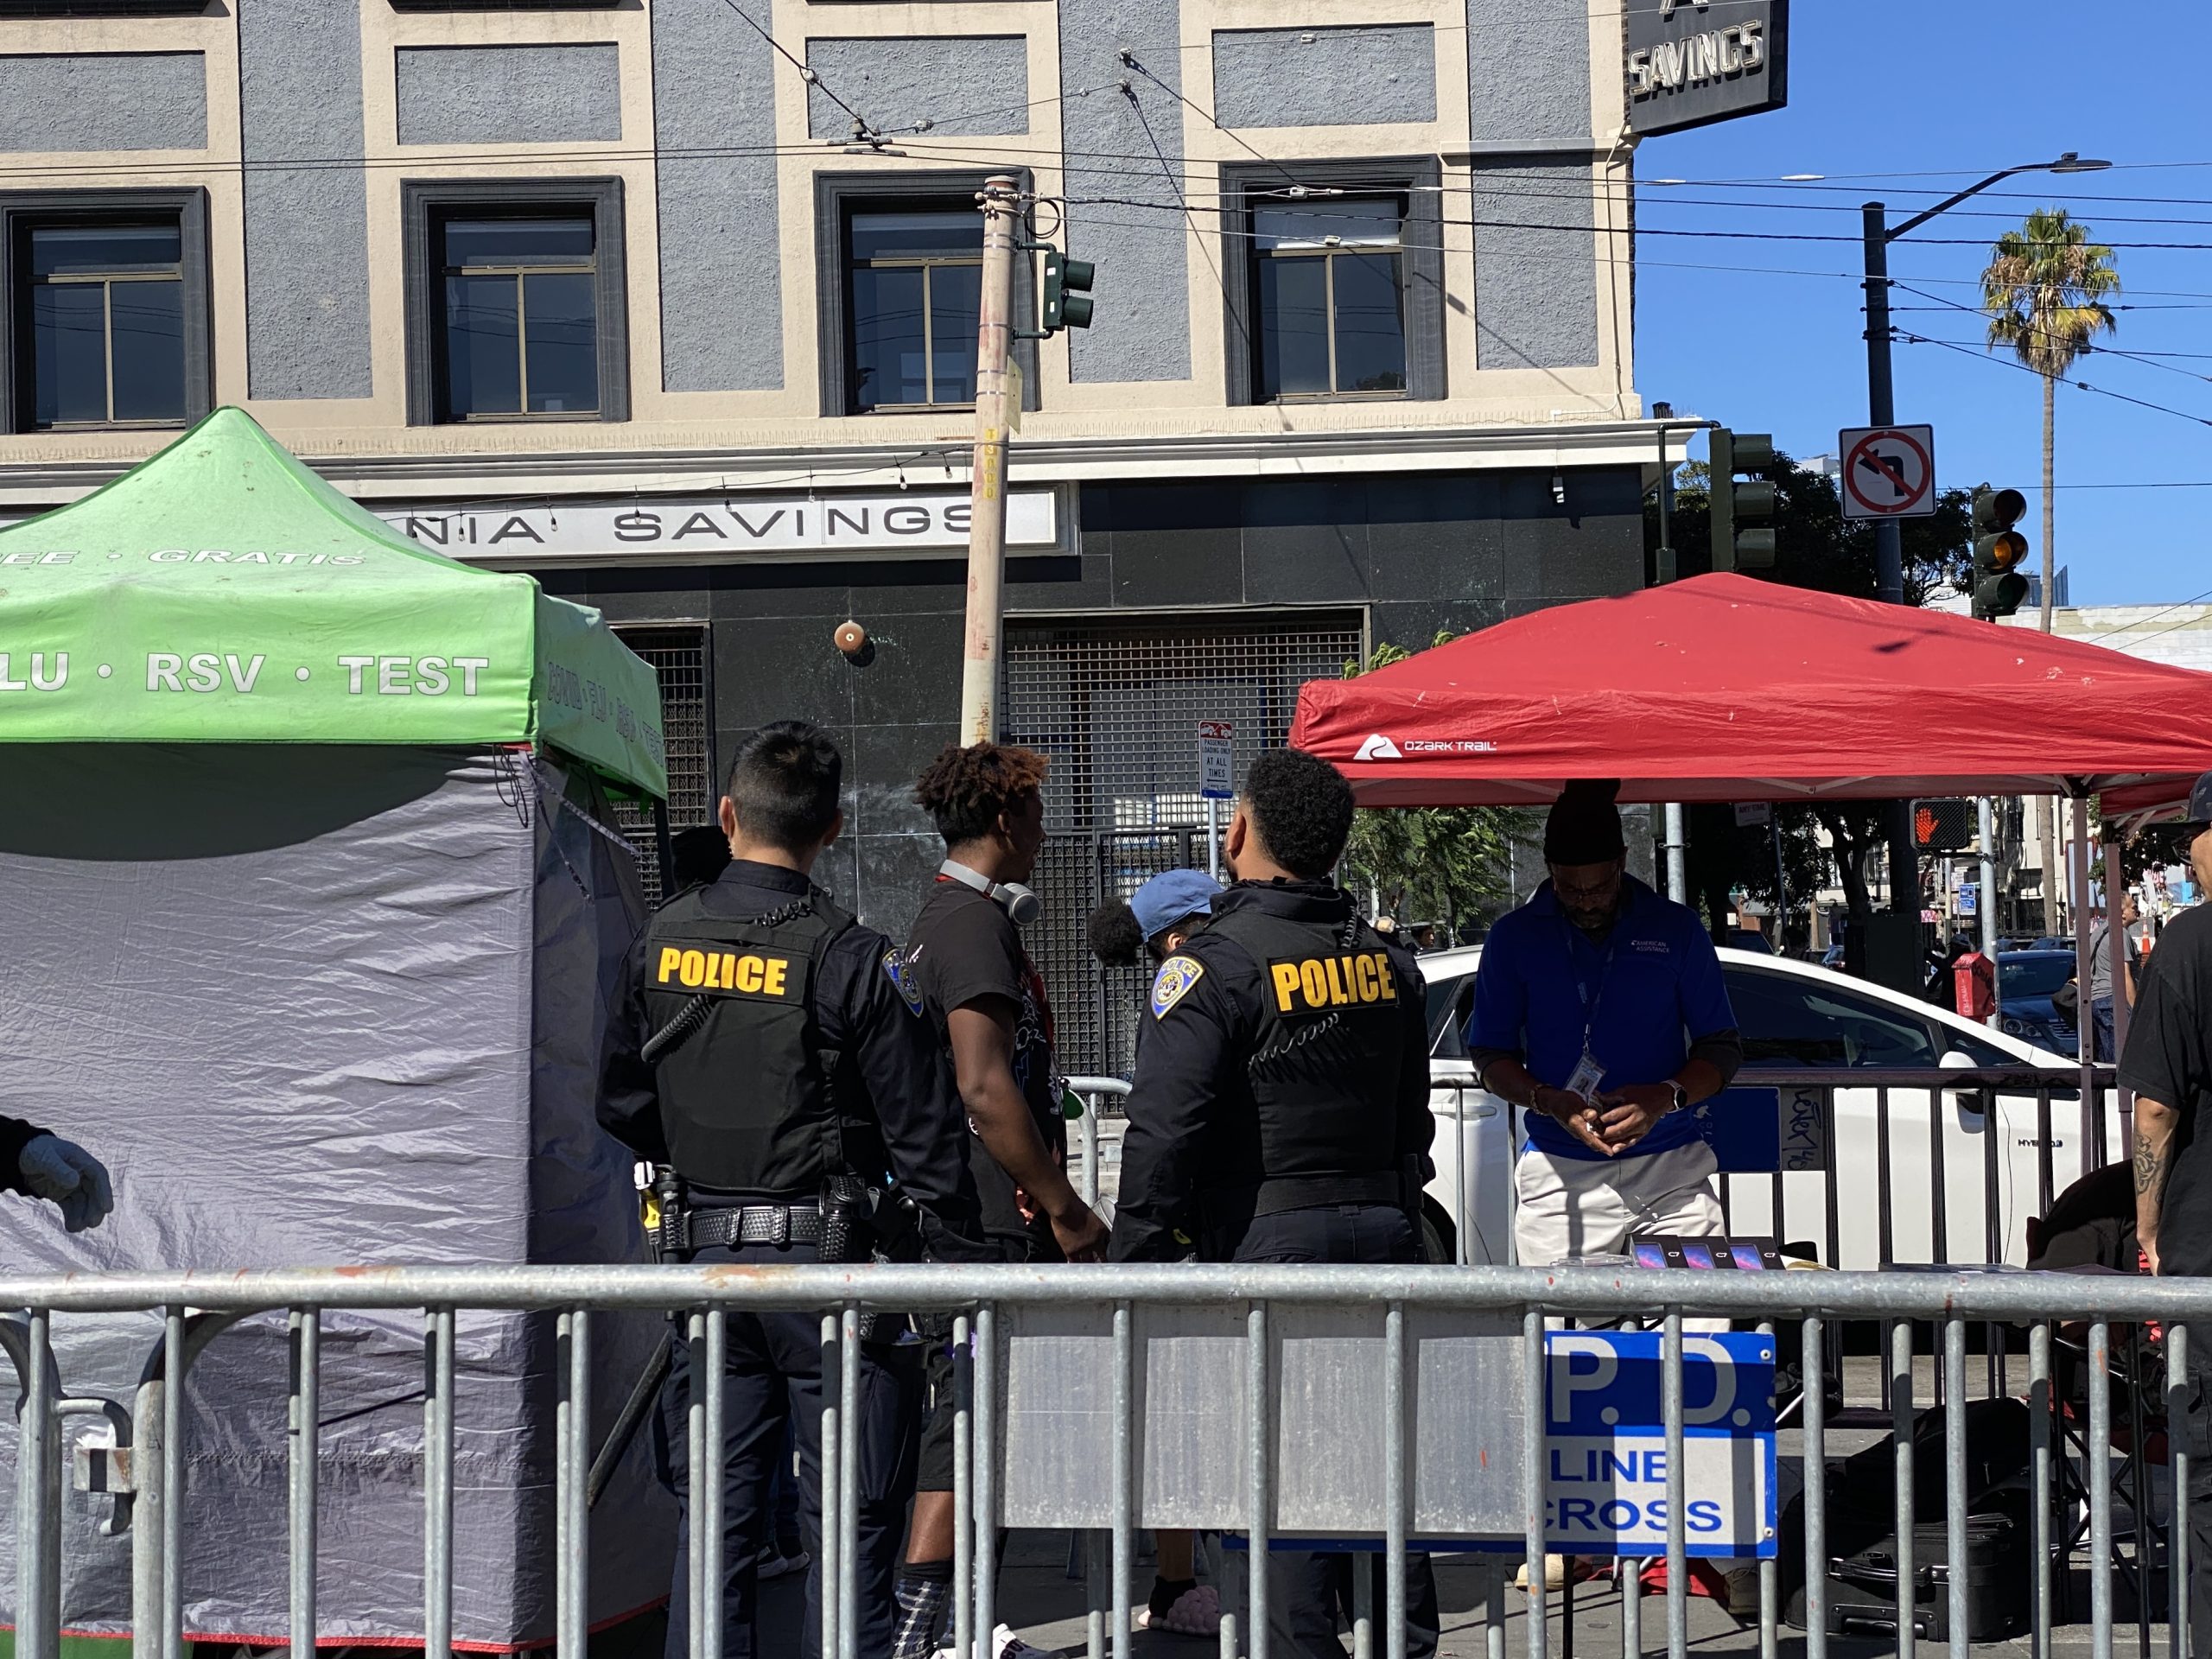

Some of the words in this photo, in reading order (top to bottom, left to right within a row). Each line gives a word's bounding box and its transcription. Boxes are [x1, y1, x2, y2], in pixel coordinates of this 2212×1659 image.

[1628, 19, 1764, 95] SAVINGS
[613, 504, 972, 542] SAVINGS
[0, 550, 80, 564] EE
[149, 550, 367, 566] GRATIS
[146, 652, 266, 693] RSV
[338, 655, 489, 696] TEST
[586, 679, 607, 722] FLU
[1207, 757, 1214, 766] AT
[1217, 758, 1227, 766] ALL
[1209, 768, 1225, 778] TIMES
[658, 947, 787, 995] POLICE
[1162, 960, 1198, 979] POLICE
[1271, 953, 1396, 1012] POLICE
[1551, 1450, 1667, 1483] LINE
